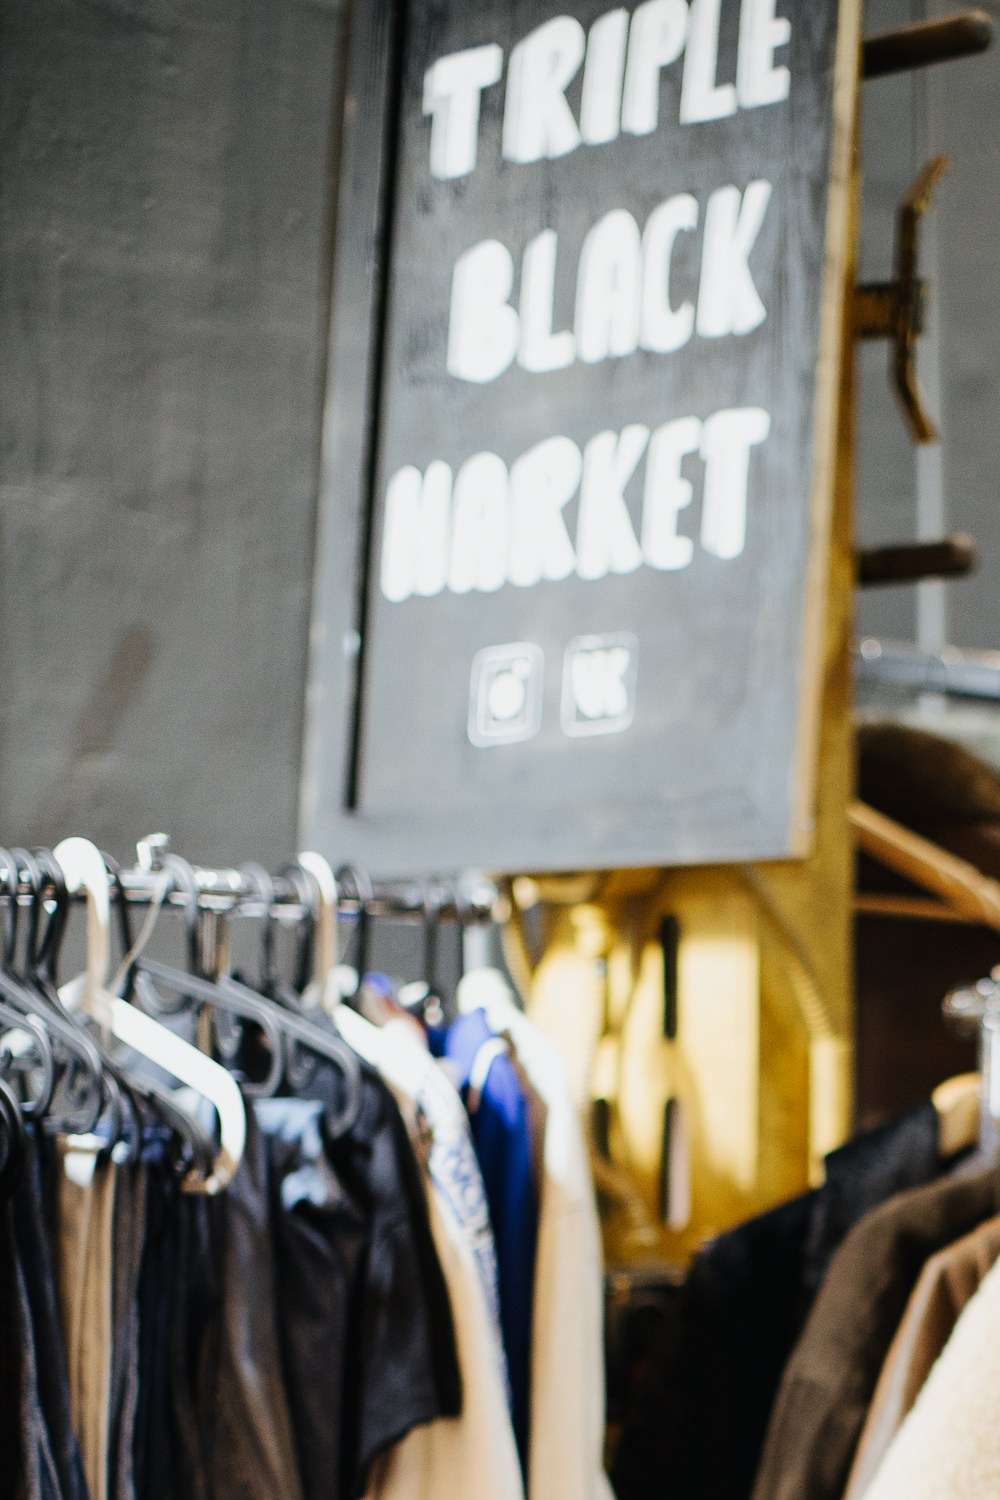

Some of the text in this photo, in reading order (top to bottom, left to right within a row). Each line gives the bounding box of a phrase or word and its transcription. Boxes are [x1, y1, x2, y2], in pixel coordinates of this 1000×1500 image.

[423, 0, 791, 181] TRIPLE
[447, 180, 771, 383] BLACK
[381, 407, 770, 602] MARKET
